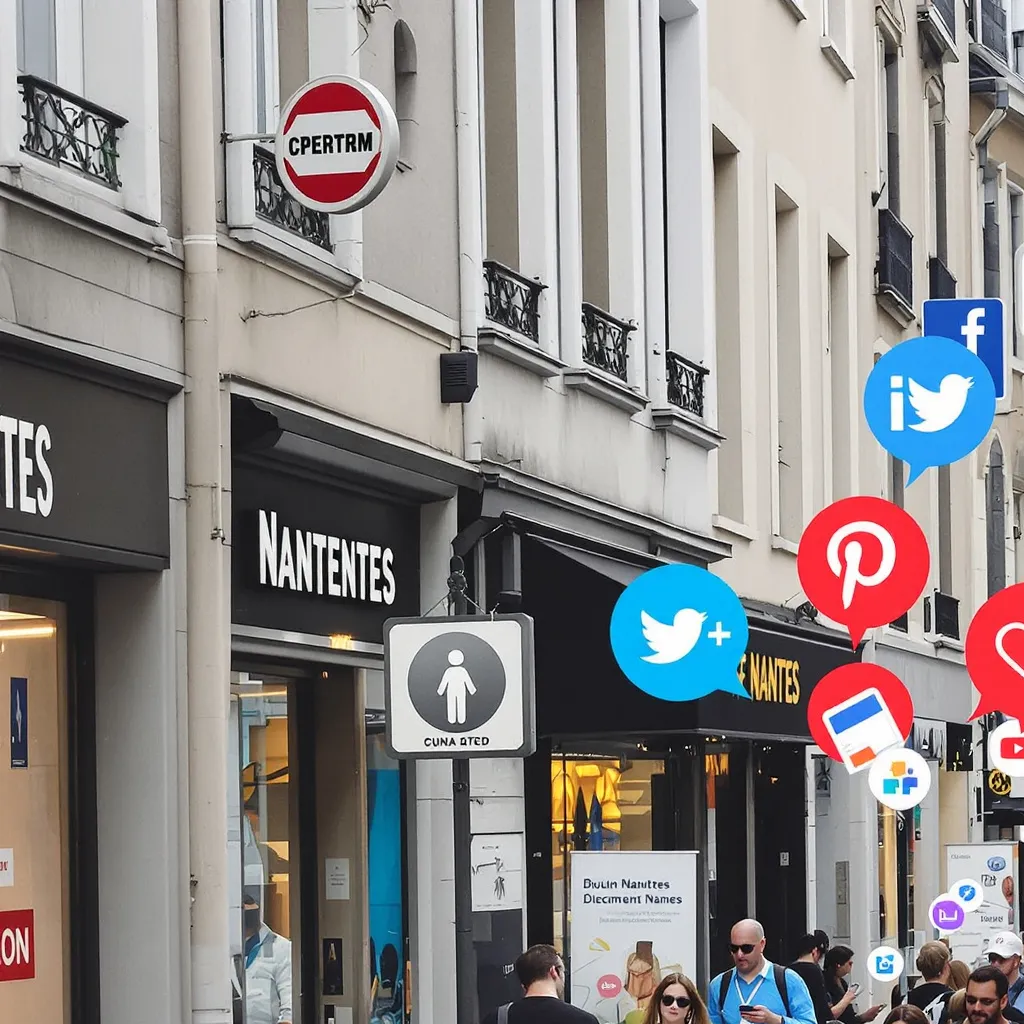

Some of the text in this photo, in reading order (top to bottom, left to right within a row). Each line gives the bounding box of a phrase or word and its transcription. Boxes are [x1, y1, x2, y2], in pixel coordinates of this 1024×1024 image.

[288, 131, 373, 156] CPERTRM
[750, 652, 800, 705] NANTES
[0, 927, 30, 966] ON
